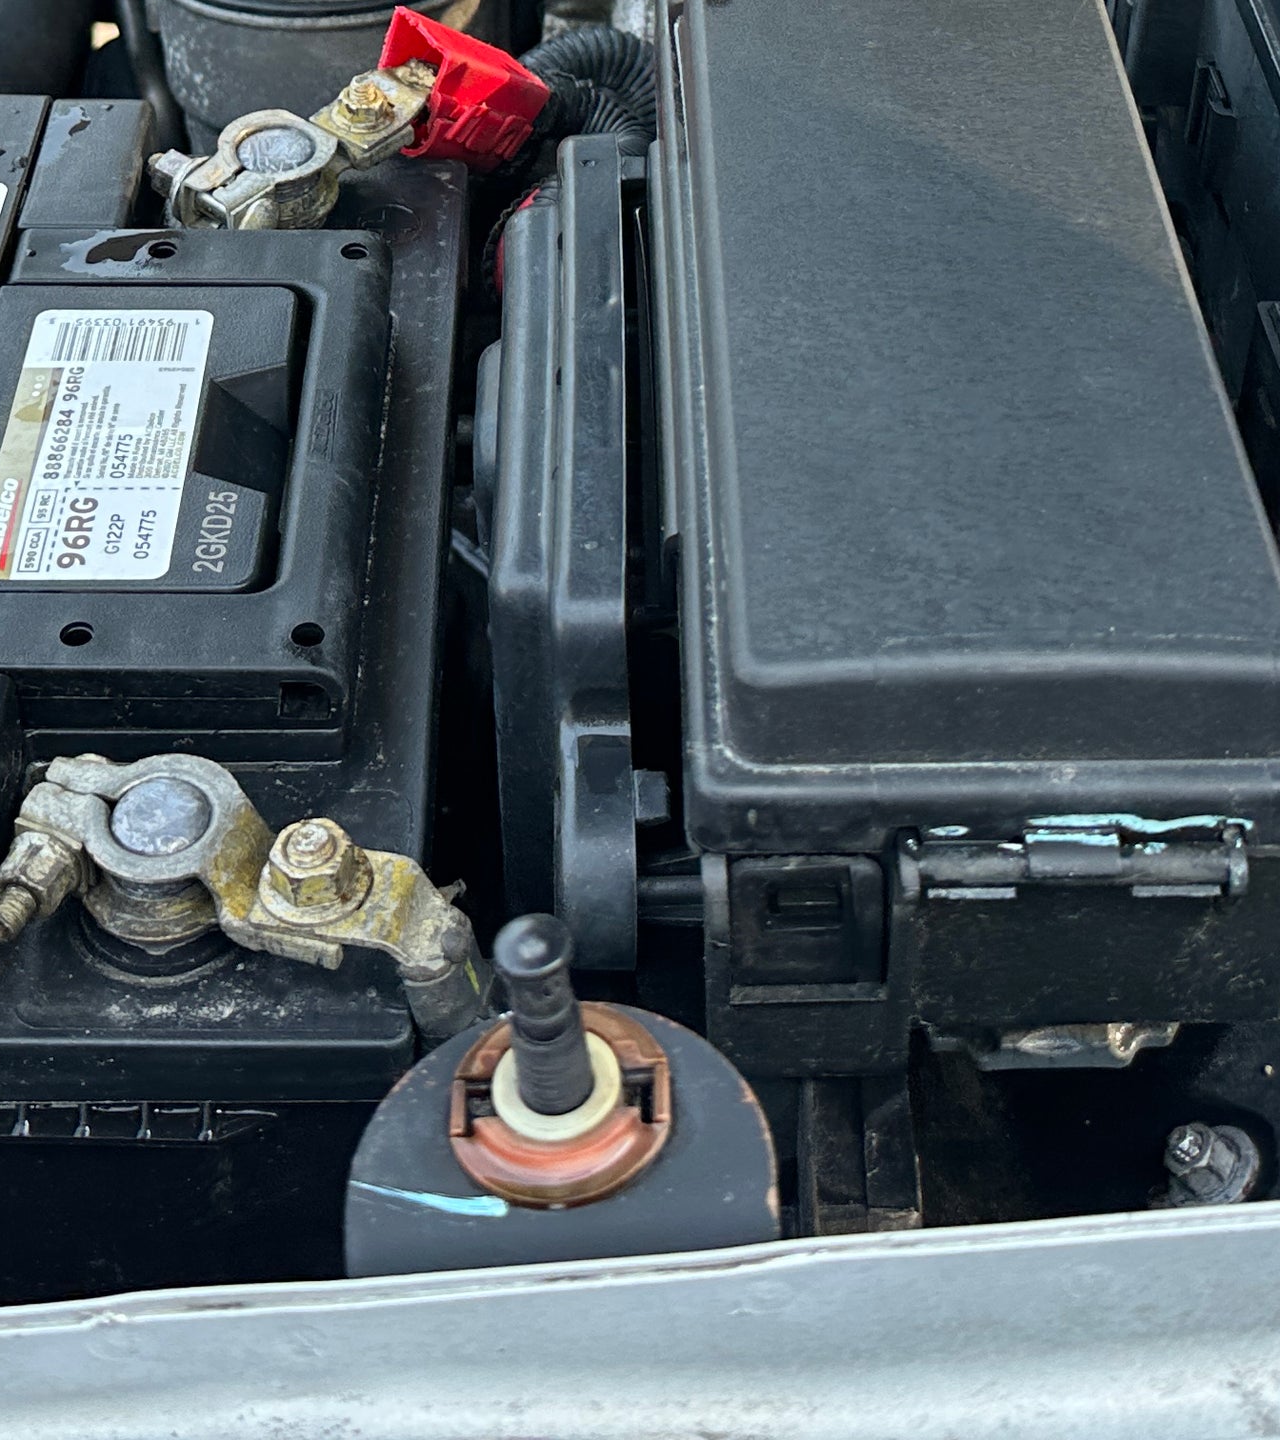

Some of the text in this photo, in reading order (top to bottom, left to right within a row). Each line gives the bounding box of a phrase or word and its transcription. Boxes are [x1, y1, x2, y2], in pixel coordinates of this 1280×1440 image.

[75, 317, 122, 327] 03395
[129, 317, 175, 327] 95491
[41, 408, 75, 479] 88866284
[61, 365, 86, 401] 96RG
[107, 433, 134, 479] 054775
[54, 496, 100, 568] 96RG
[102, 512, 127, 554] G122P
[132, 509, 158, 559] 054775
[192, 491, 239, 573] 2GKD25
